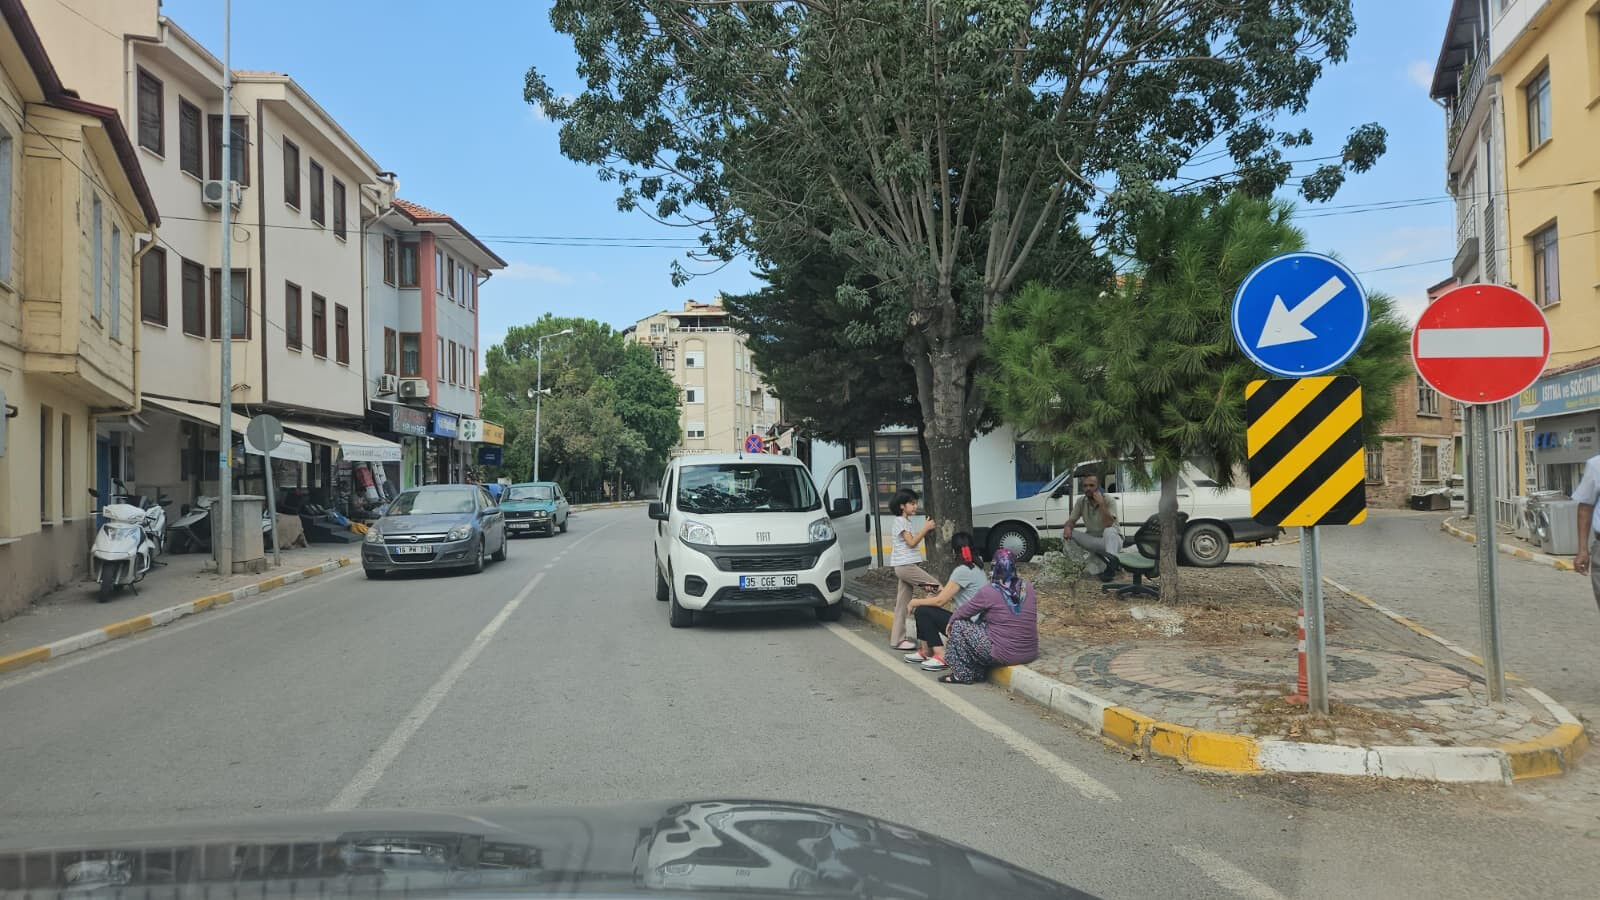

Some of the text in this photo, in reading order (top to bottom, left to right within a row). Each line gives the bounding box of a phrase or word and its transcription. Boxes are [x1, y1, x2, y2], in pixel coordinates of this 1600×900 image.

[1542, 383, 1562, 401] ISITMA
[1562, 385, 1570, 398] ve
[756, 531, 771, 542] FIAT
[746, 576, 796, 587] 35 CGE 196
